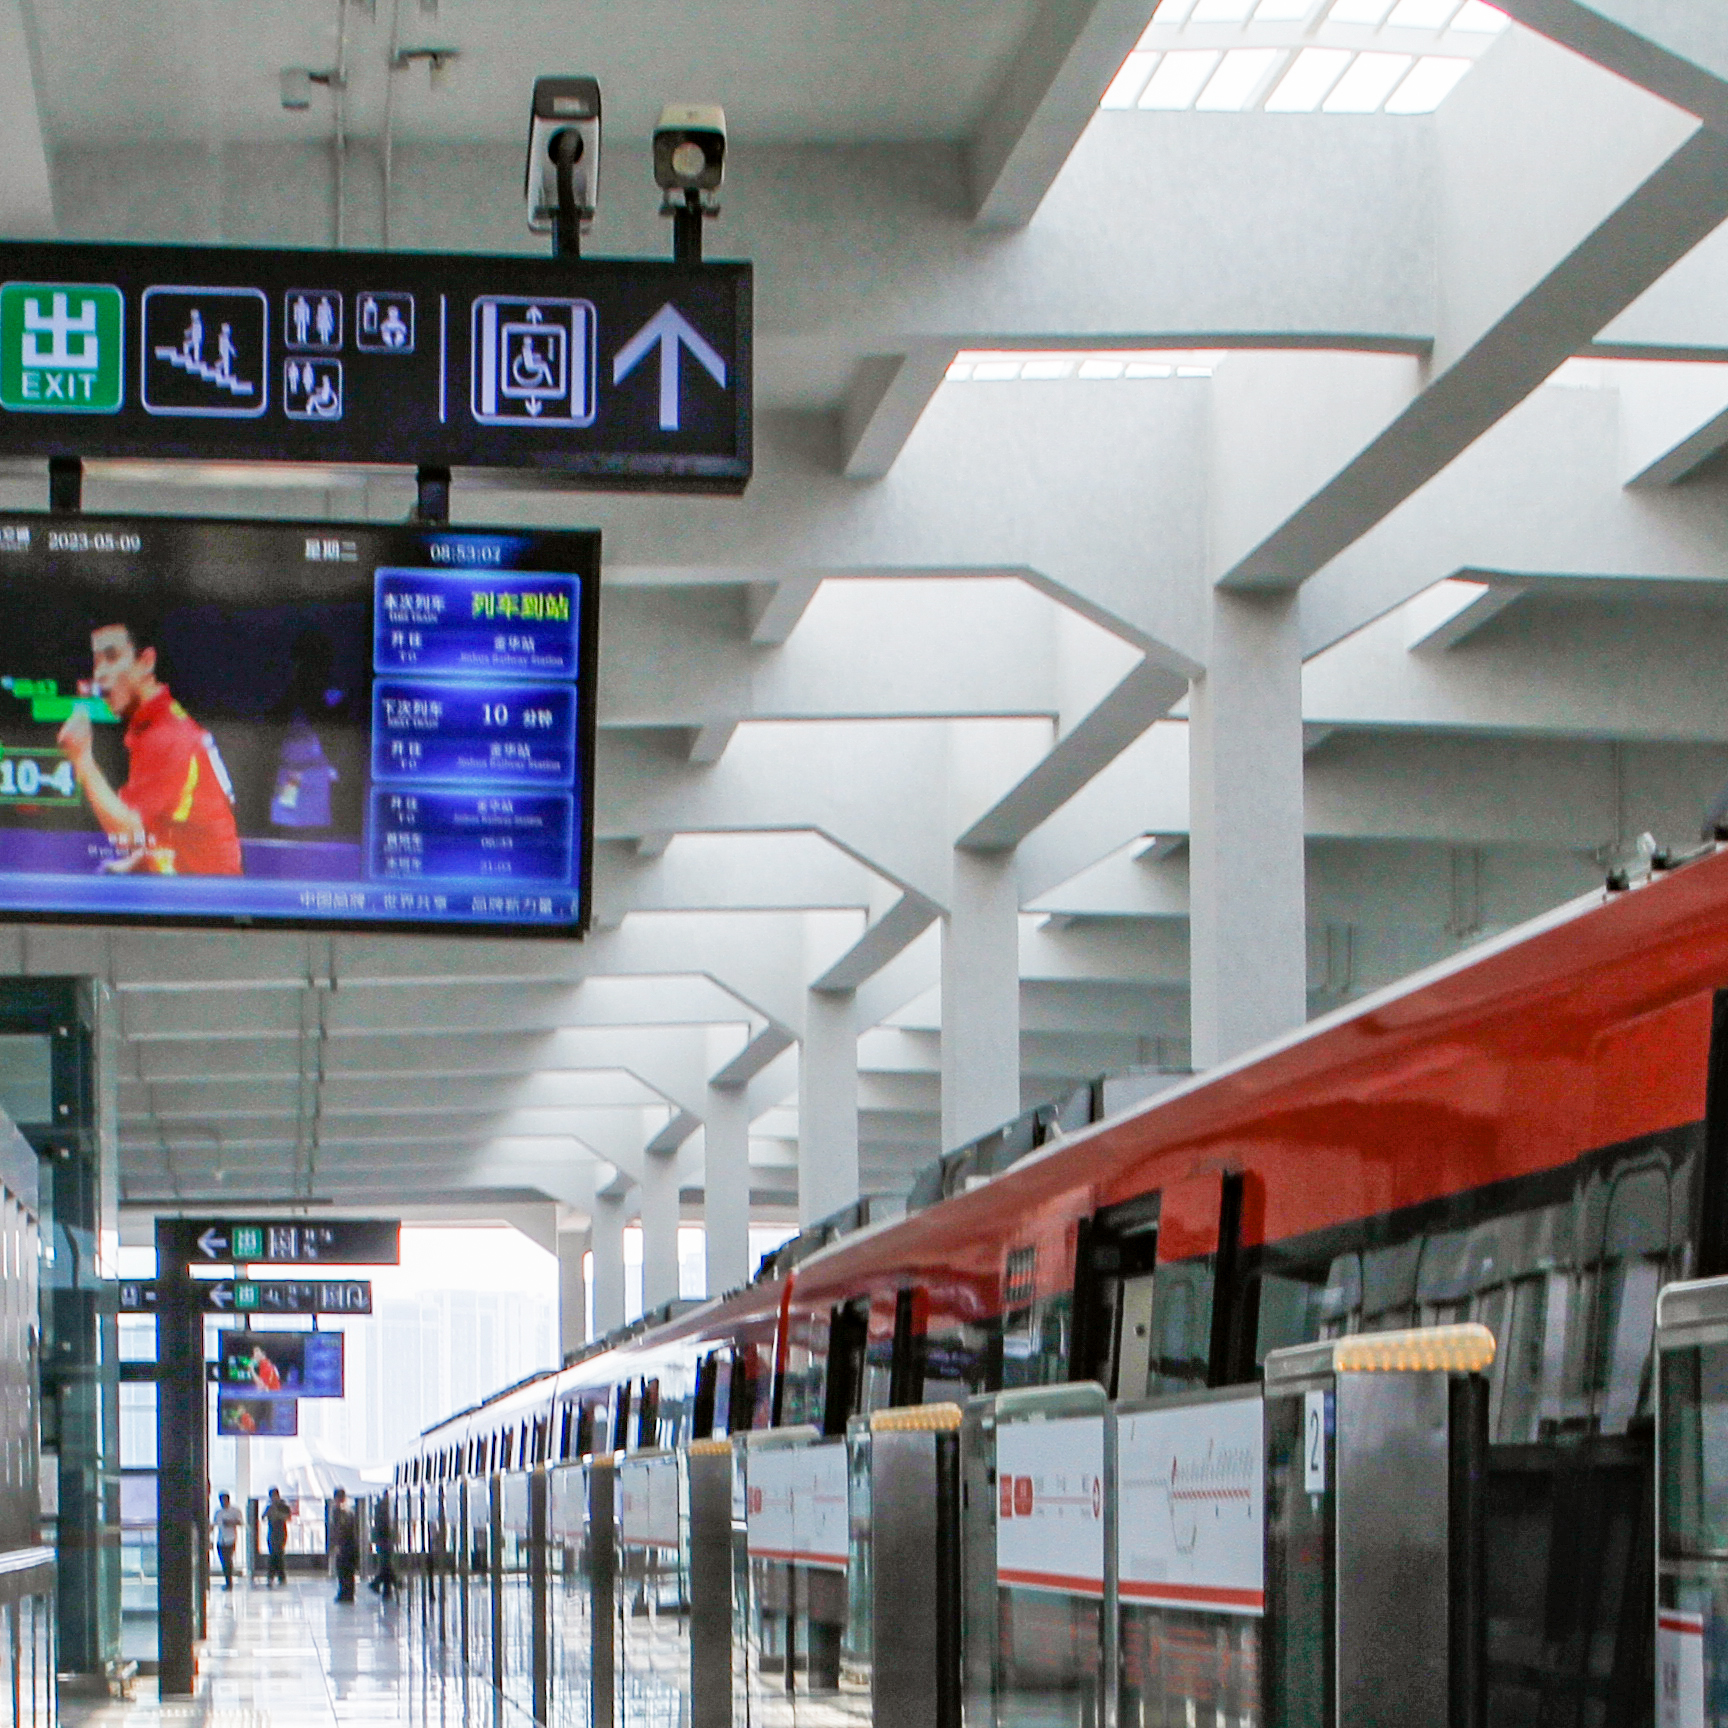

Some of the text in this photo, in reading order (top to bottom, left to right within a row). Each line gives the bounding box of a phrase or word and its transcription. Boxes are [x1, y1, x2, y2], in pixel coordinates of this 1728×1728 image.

[21, 371, 97, 400] EXIT
[48, 531, 142, 553] 2023-05-09
[305, 538, 359, 562] 星期二
[471, 591, 570, 622] 列车到站
[483, 703, 509, 727] 10
[1309, 1408, 1320, 1472] 2
